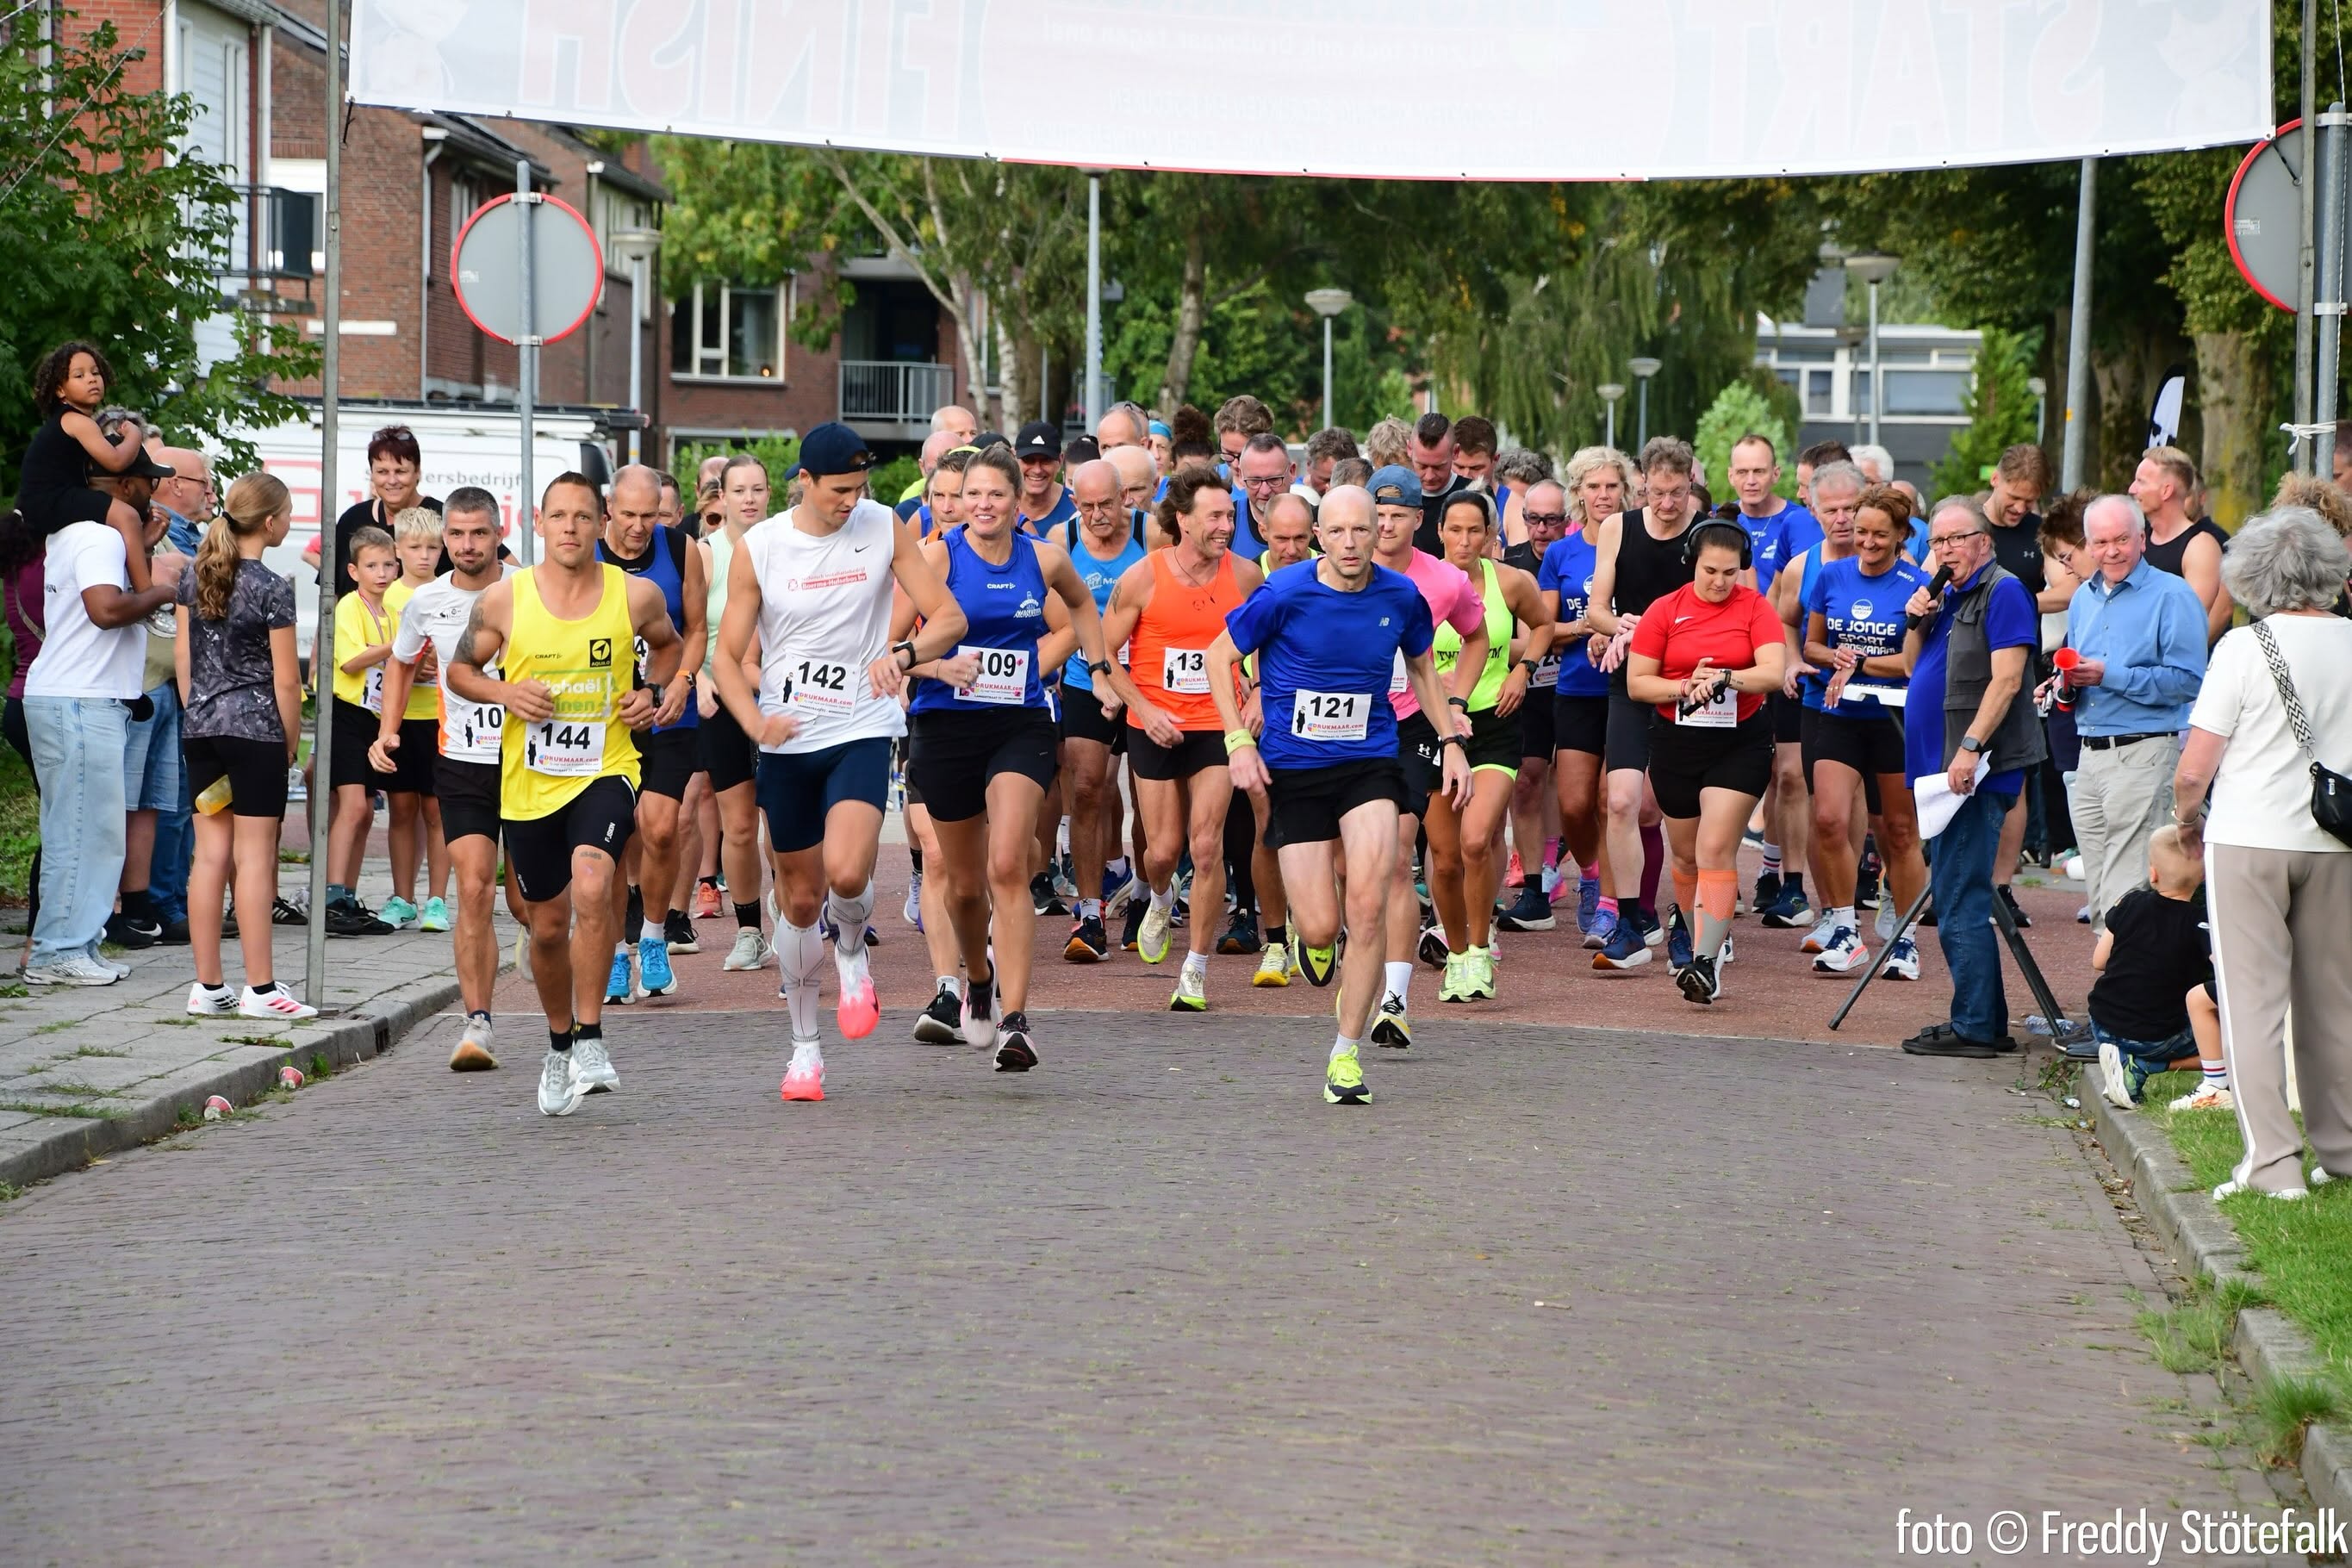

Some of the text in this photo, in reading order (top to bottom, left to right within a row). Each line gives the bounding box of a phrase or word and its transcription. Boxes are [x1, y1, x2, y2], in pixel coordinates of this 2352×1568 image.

[1566, 598, 1583, 610] DE
[1827, 617, 1896, 636] DE JONGE
[1839, 633, 1885, 646] SPORT
[1178, 652, 1204, 671] 13
[799, 661, 846, 690] 142
[800, 692, 853, 706] DRUKMAAR.com
[1310, 696, 1354, 718] 121
[474, 707, 501, 728] 10
[541, 723, 590, 750] 144
